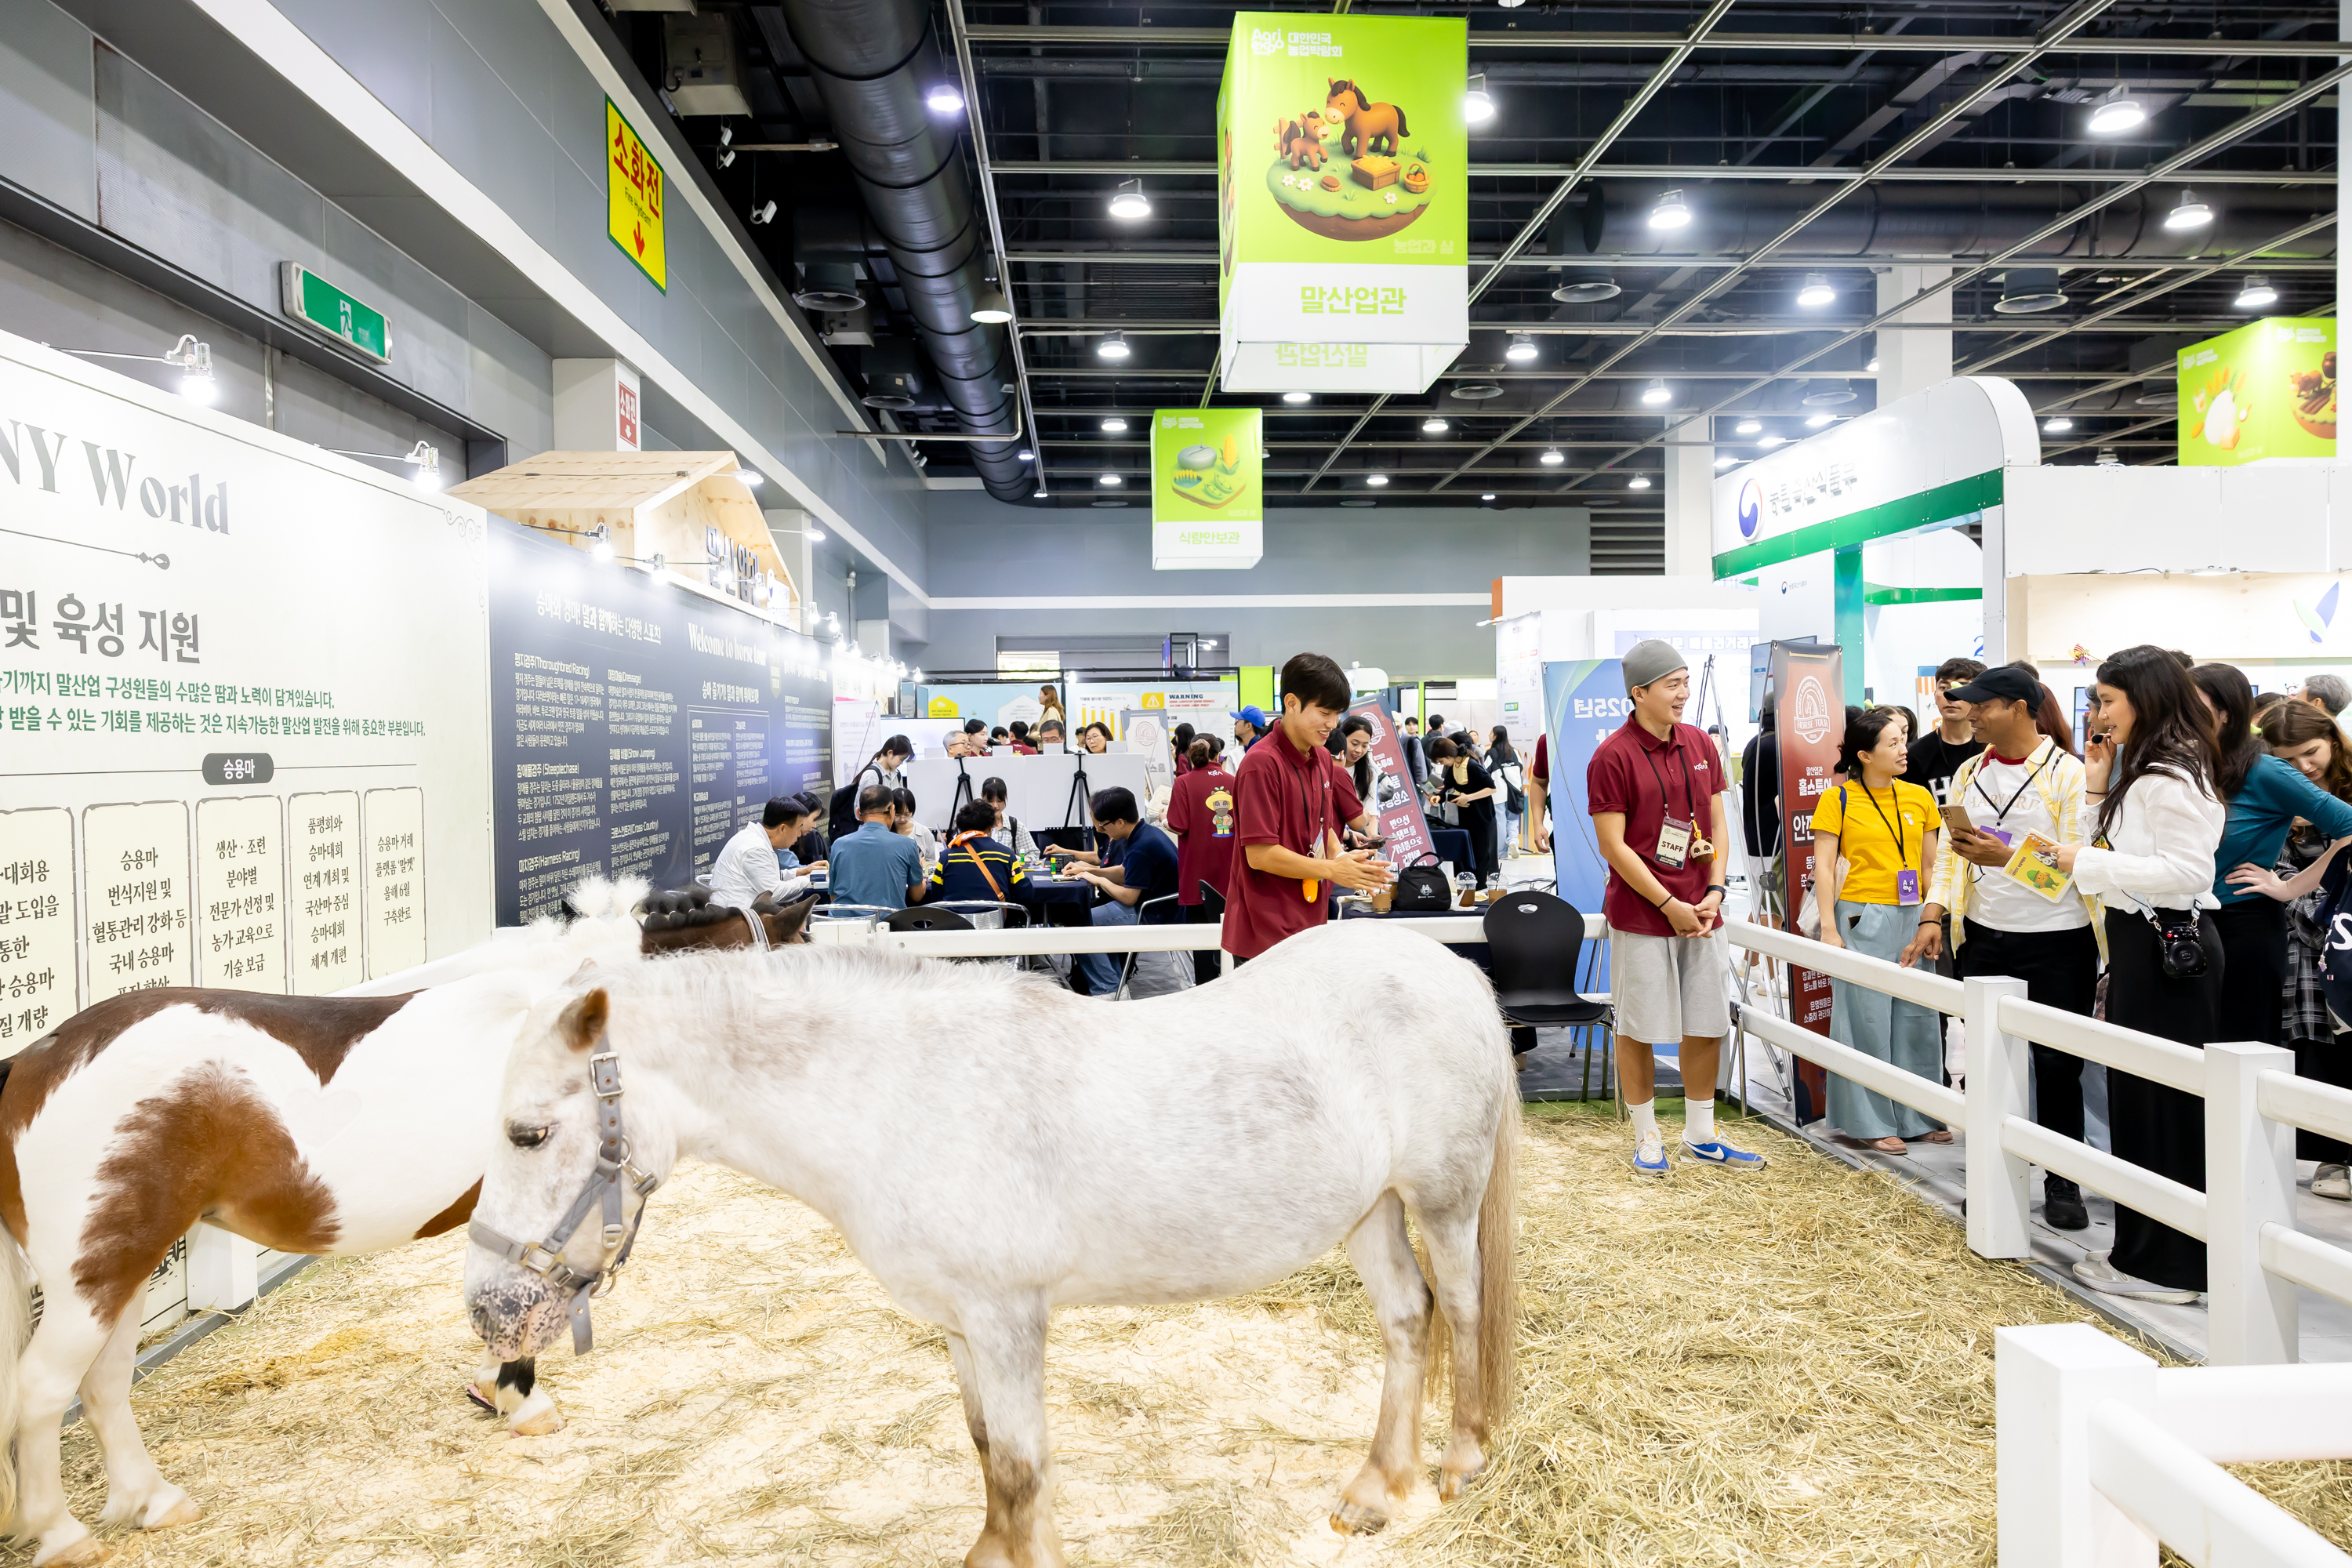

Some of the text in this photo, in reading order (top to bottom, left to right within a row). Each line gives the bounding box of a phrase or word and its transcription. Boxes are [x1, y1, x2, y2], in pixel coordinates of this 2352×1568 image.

[1251, 28, 1281, 42] Agri
[1288, 32, 1331, 45] 대한민국
[1288, 45, 1342, 57] 농업박람회
[614, 122, 659, 220] 소화전
[625, 187, 633, 206] Fire
[1394, 239, 1454, 255] 농업과 삶
[1301, 286, 1407, 314] 말산업관
[620, 389, 636, 425] 소화전
[81, 440, 230, 535] World
[1179, 532, 1240, 544] 식량안보관
[0, 590, 200, 664] 및 육성 지원
[583, 604, 597, 630] 말과
[598, 607, 623, 637] 함께하는
[625, 617, 643, 641] 다양한
[688, 622, 767, 666] Welcome to horse tour
[0, 670, 335, 709] 기까지 말산업 구성원들의 수많은 땀과 노력이 담겨있습니다.
[702, 681, 712, 699] 승마
[9, 706, 42, 731] 받을
[46, 707, 62, 731] 수
[67, 708, 96, 731] 있는
[100, 710, 142, 732] 기회를
[146, 711, 196, 733] 제공하는
[200, 713, 223, 734] 것은
[226, 714, 279, 735] 지속가능한
[282, 717, 310, 735] 말산업
[314, 717, 340, 735] 발전을
[343, 718, 360, 735] 위해
[361, 719, 386, 736] 중요한
[387, 720, 426, 737] 부분입니다.
[1797, 718, 1829, 729] HORSE TOUR
[223, 759, 255, 779] 승용마
[543, 762, 579, 778] (Steeplechase)
[1376, 757, 1394, 768] 스투어
[1806, 766, 1823, 776] 말산업관
[1391, 775, 1401, 789] 품
[1798, 778, 1832, 796] 홀스투어
[308, 815, 343, 834] 품평회와
[216, 836, 266, 859] 생산 조련
[309, 841, 343, 862] 승마대회
[378, 833, 413, 852] 승용마 거래
[1661, 840, 1683, 852] STAFF
[120, 847, 158, 871] 승용마
[376, 860, 396, 877] 플랫폼
[1806, 856, 1816, 869] 동
[0, 859, 49, 886] 대회용
[227, 866, 257, 887] 분야별
[303, 866, 350, 890] 연계 개최 및
[108, 877, 171, 906] 번식지원 및
[383, 881, 410, 901] 올해 6월
[16, 895, 60, 920] 도입을
[209, 893, 274, 921] 전문가 선정 및
[305, 893, 349, 917] 국산마 중심
[383, 907, 412, 926] 구축완료
[92, 909, 187, 944] 혈통관리 강화 등
[212, 924, 274, 952] 농가 교육으로
[311, 920, 345, 943] 승마대회
[0, 935, 30, 963] 통한
[109, 942, 174, 975] 국내 승용마
[311, 946, 347, 970] 체계 개편
[223, 953, 265, 979] 기술 보급
[9, 967, 55, 998] 승용마
[1818, 978, 1827, 988] 바로
[17, 1005, 48, 1032] 개량
[1804, 1008, 1832, 1023] 소중히 관리하
